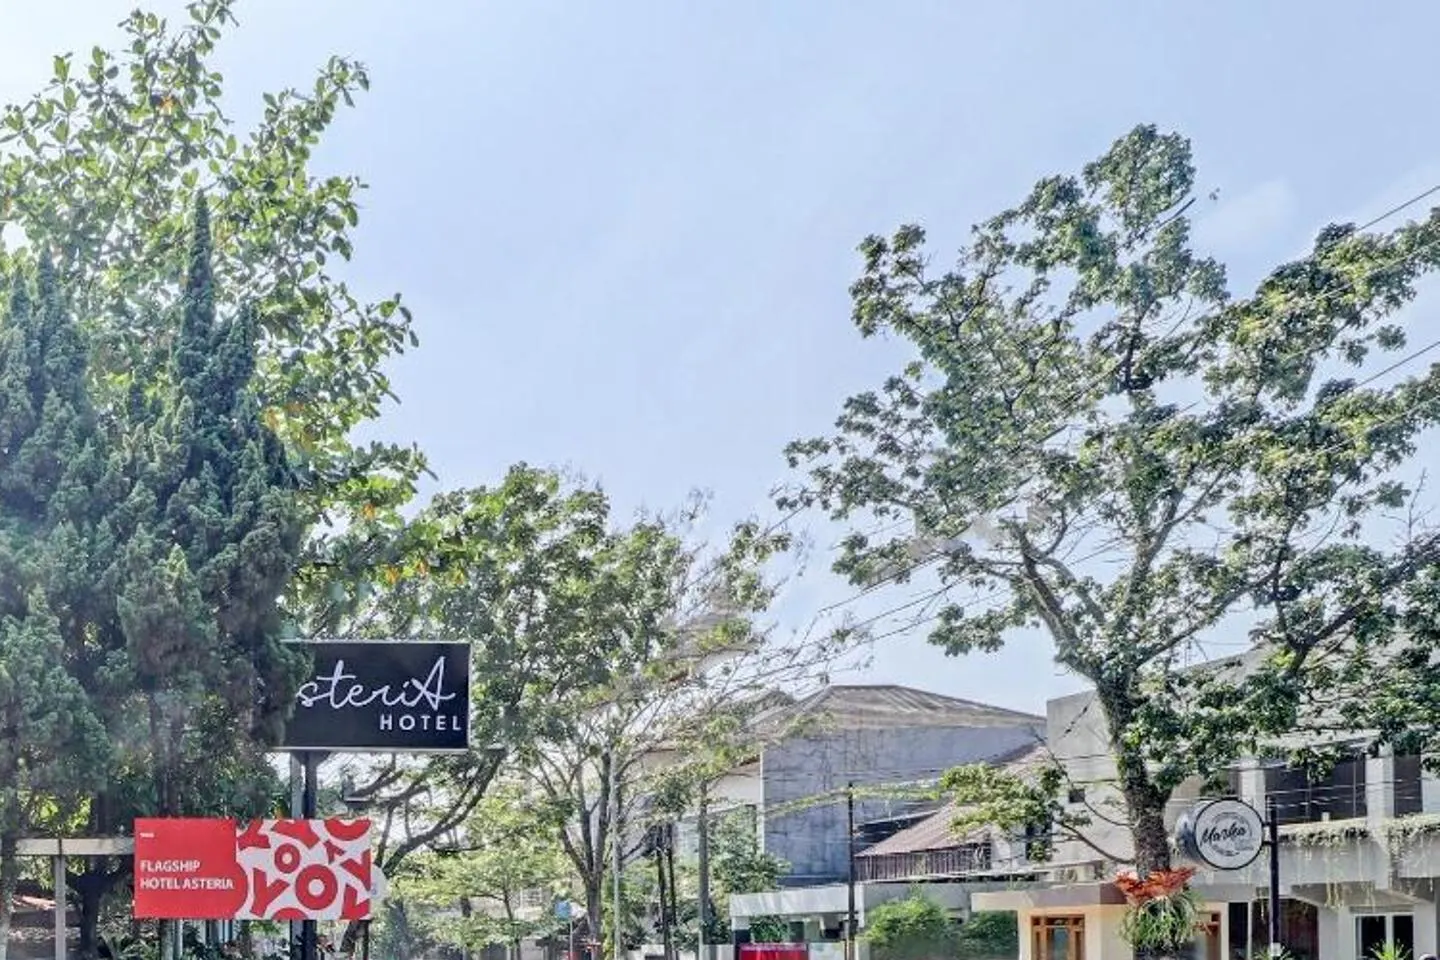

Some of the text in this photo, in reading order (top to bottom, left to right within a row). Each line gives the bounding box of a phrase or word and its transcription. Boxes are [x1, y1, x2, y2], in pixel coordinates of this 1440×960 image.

[295, 656, 456, 711] steriA
[379, 714, 462, 731] HOTEL
[139, 859, 201, 873] FLAGSHIP
[139, 876, 235, 890] HOTEL ASTERIA
